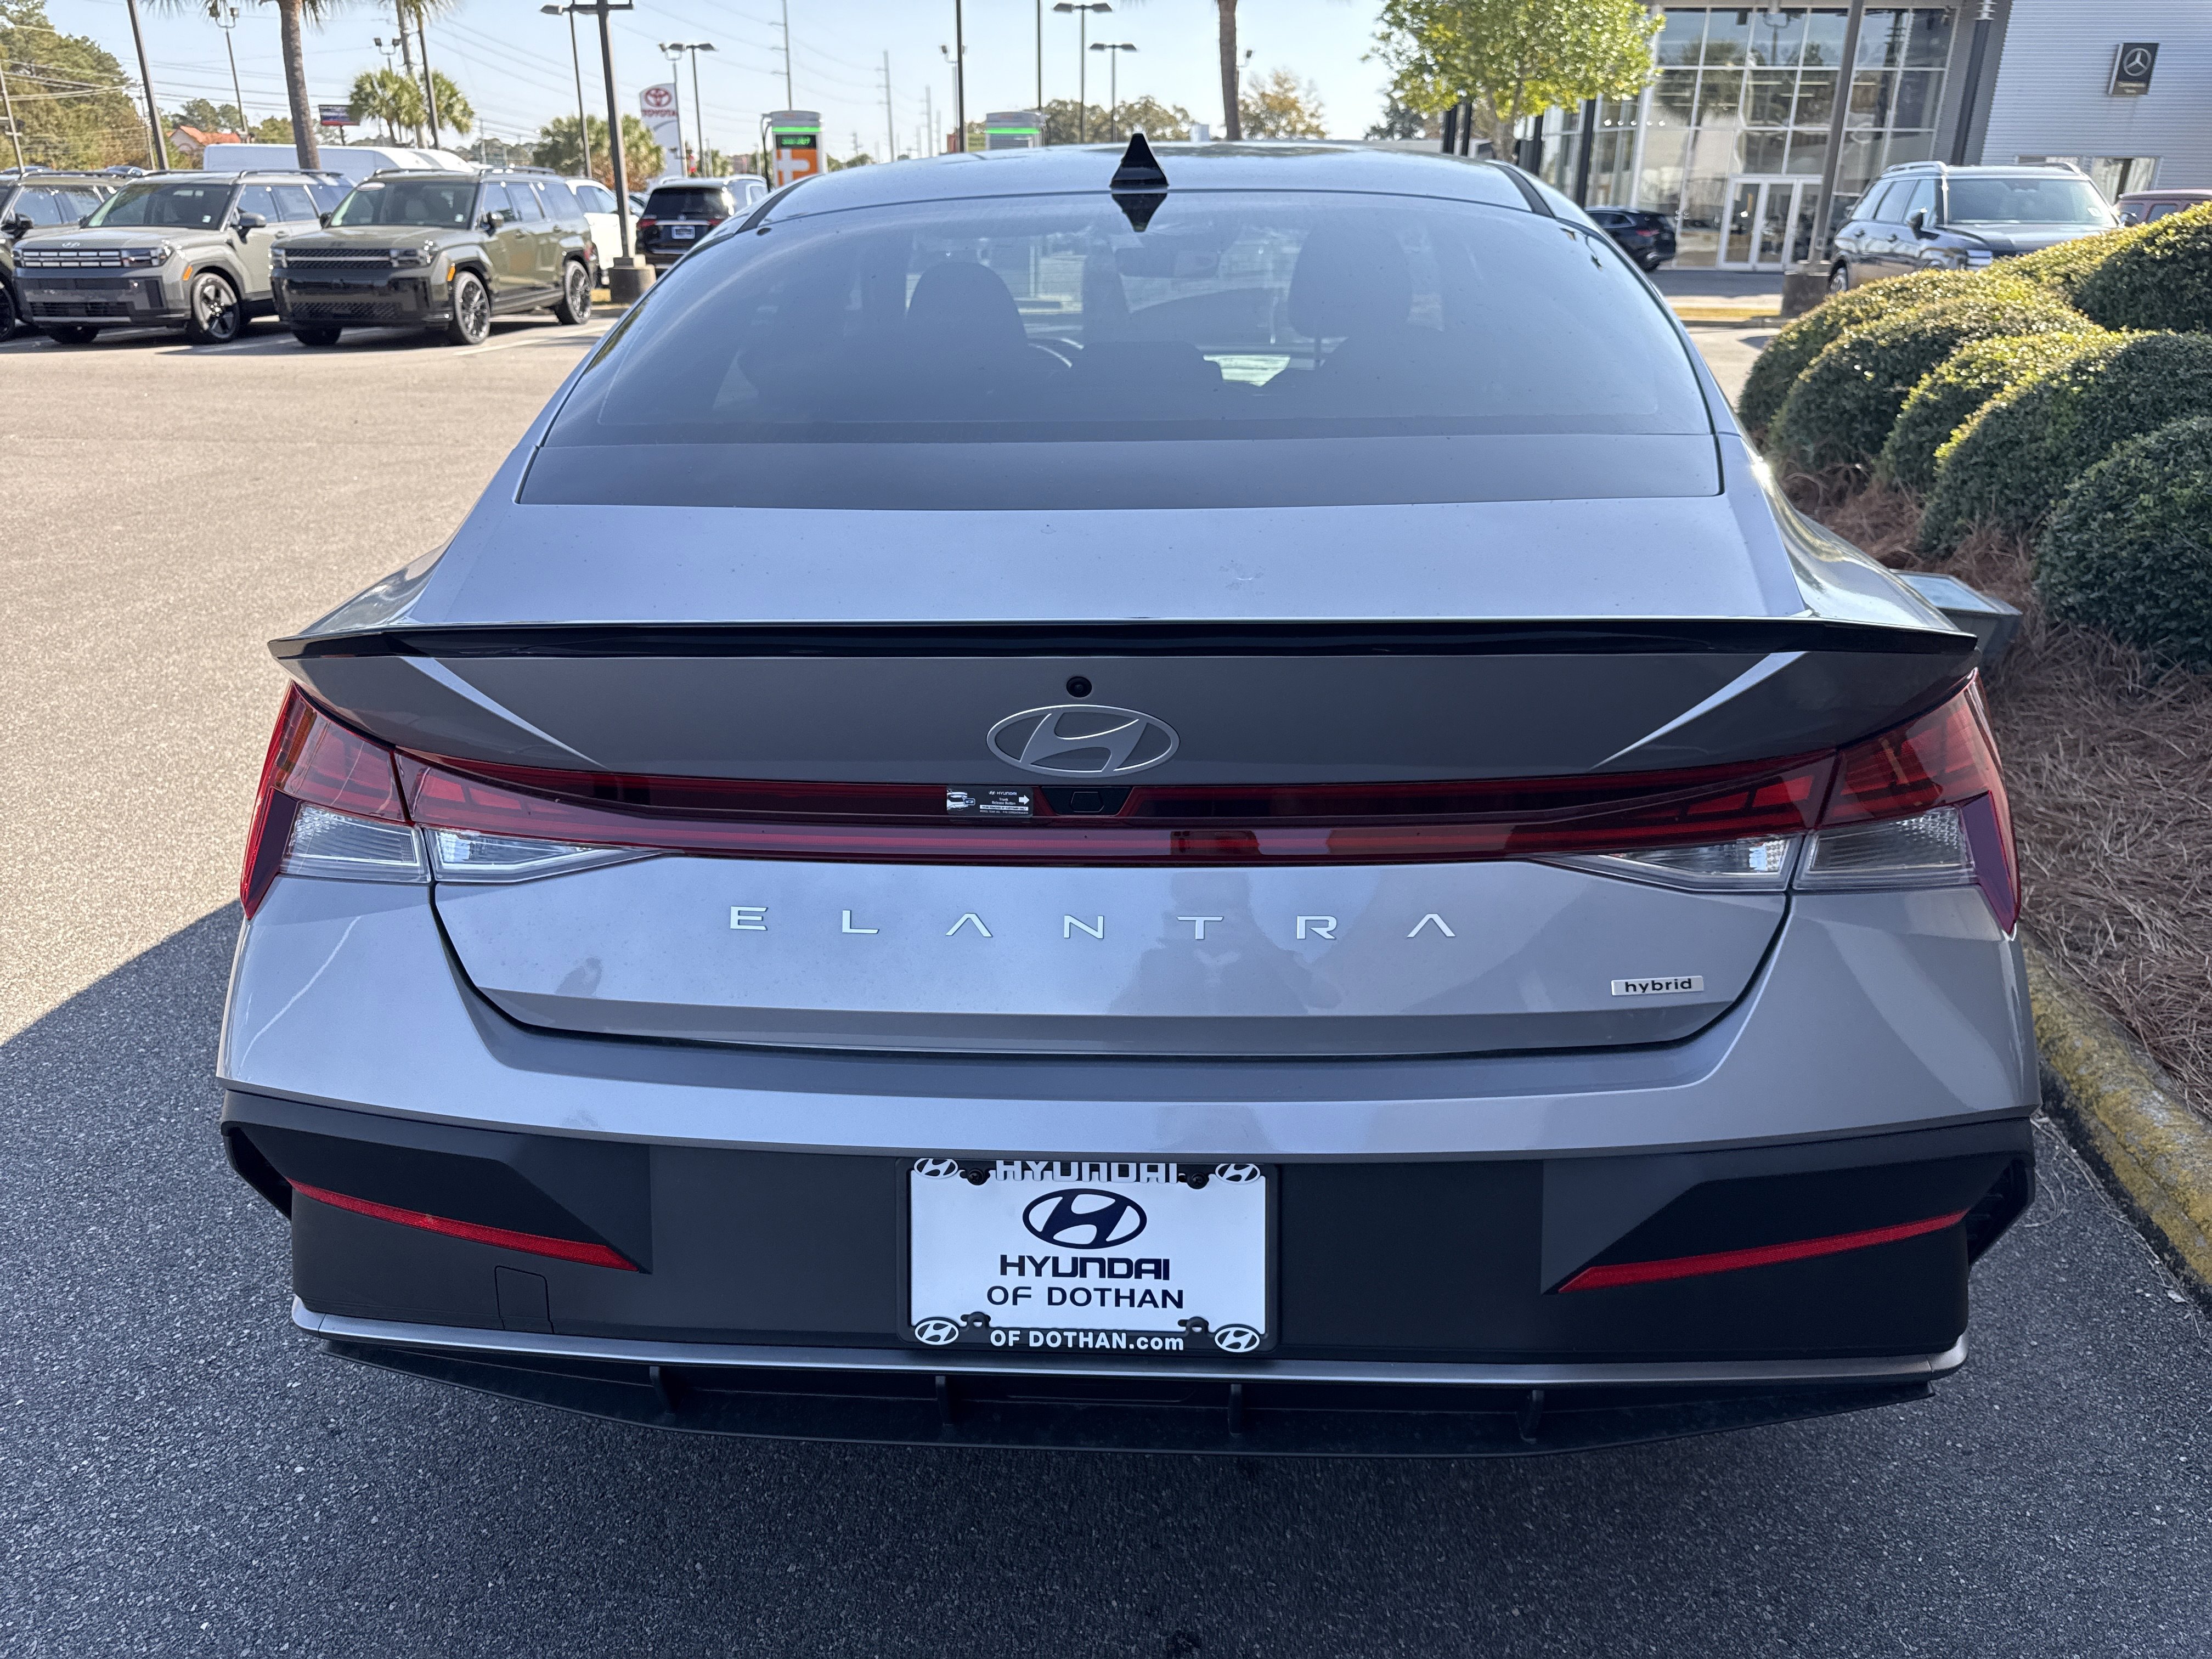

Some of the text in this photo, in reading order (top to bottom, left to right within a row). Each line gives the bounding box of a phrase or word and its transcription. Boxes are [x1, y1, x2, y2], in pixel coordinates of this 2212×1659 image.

[642, 109, 677, 117] TOYOTA
[730, 905, 1456, 939] ELANTRA
[1624, 978, 1692, 994] hybrid
[996, 1160, 1178, 1184] HYUNDAI
[1000, 1254, 1170, 1280] HYUNDAI
[987, 1285, 1184, 1309] OF DOTHAN
[990, 1329, 1184, 1351] OF DOTHAN.com
